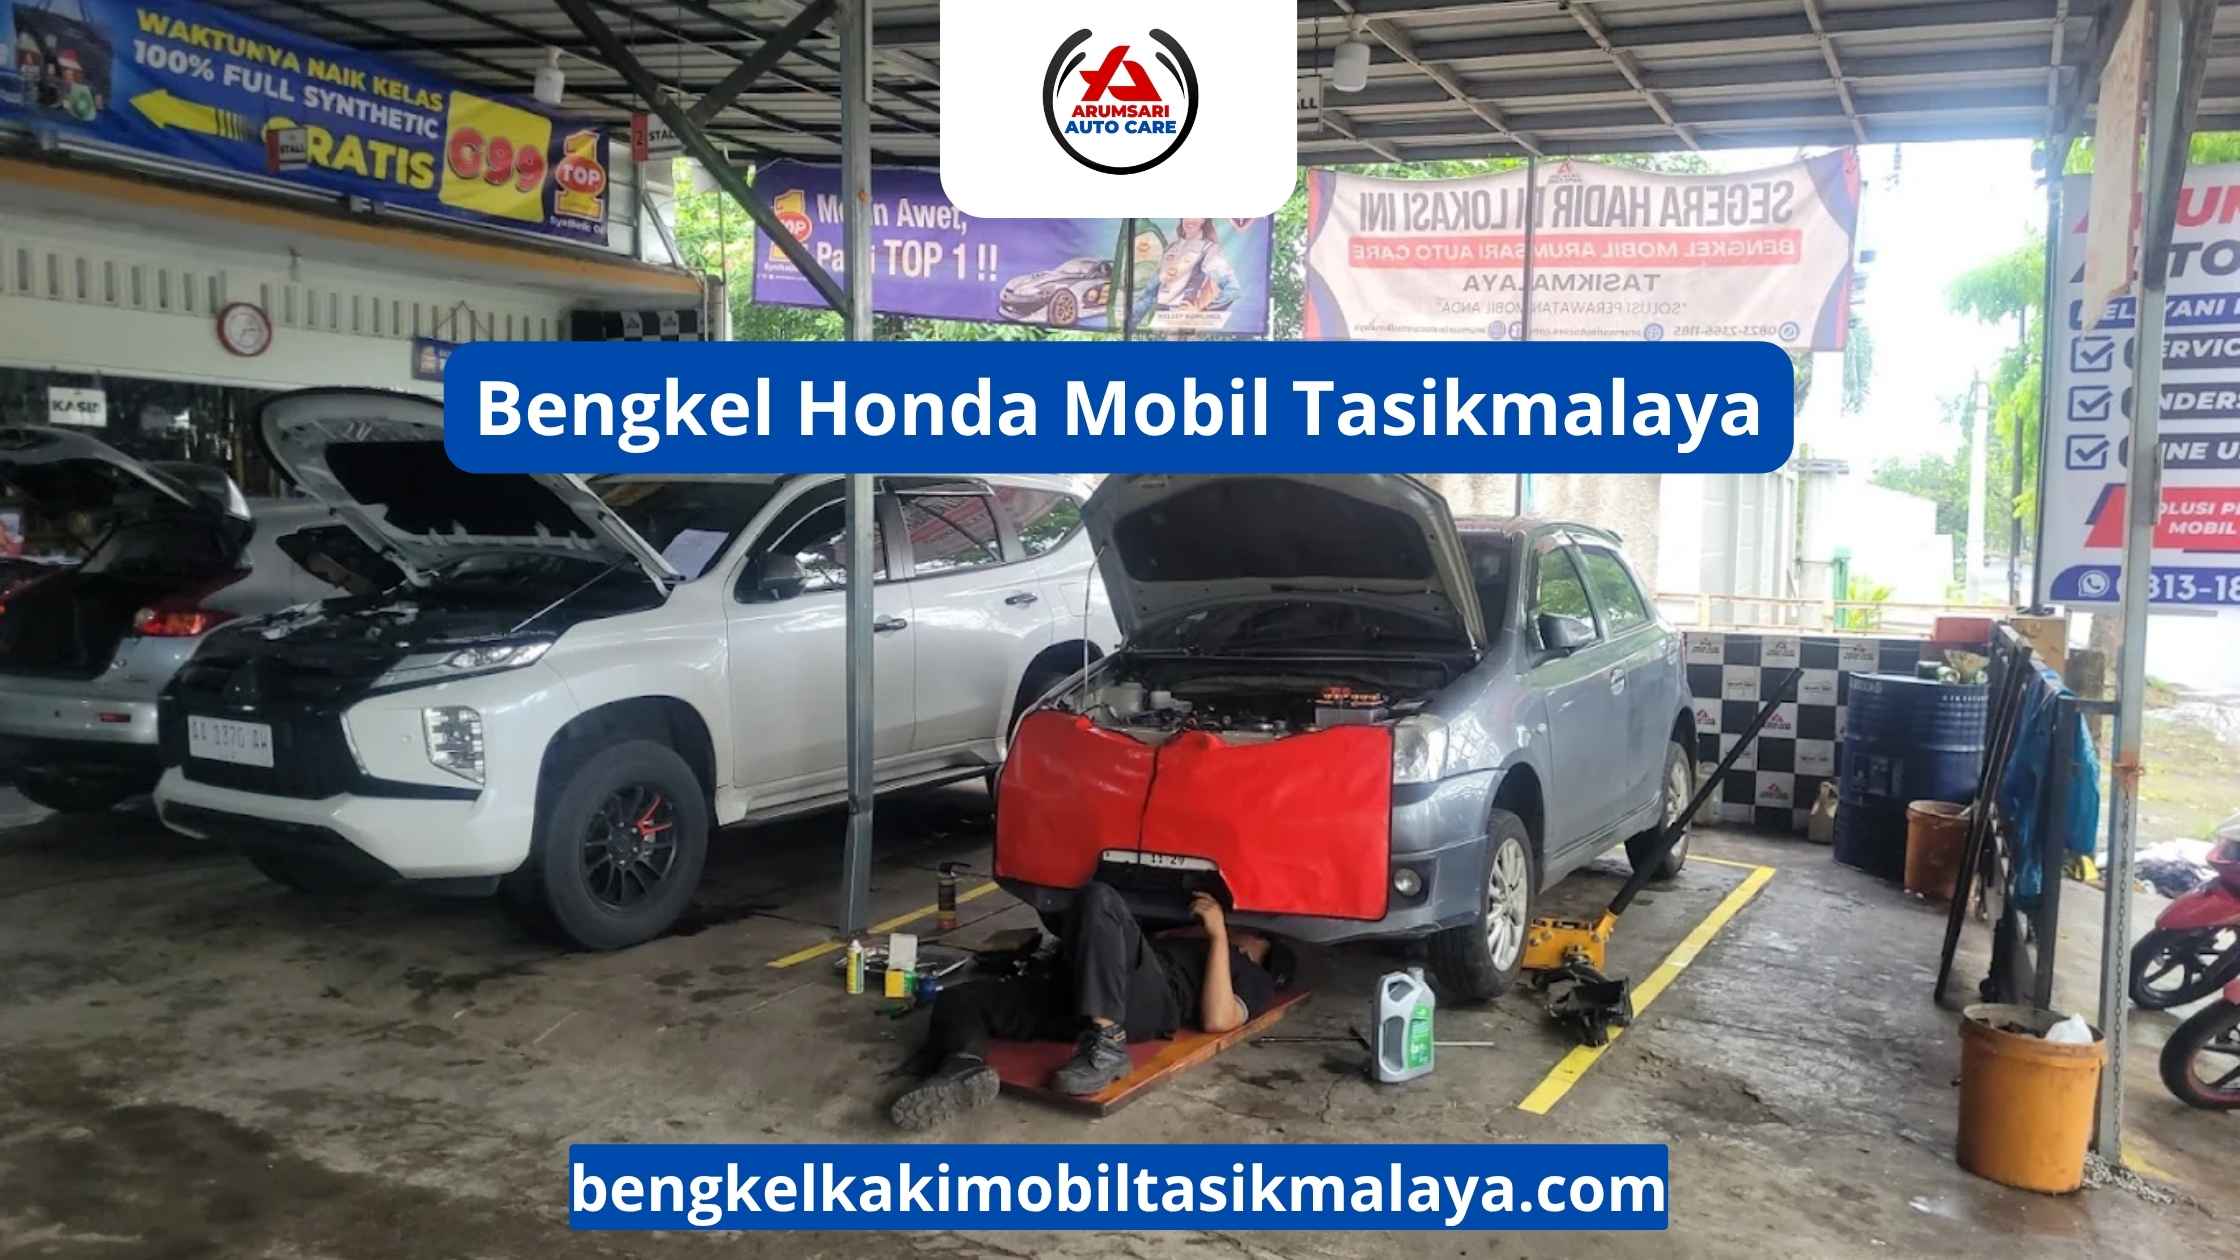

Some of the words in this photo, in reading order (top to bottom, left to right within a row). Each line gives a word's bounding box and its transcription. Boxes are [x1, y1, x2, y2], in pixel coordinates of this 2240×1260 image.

[137, 9, 300, 73] WAKTUNYA
[307, 57, 366, 91] NAIK
[373, 76, 443, 112] KELAS
[133, 39, 215, 82] 100%
[223, 64, 295, 102] FULL
[303, 85, 439, 139] SYNTHETIC
[562, 164, 599, 187] TOP
[896, 195, 968, 236] Awet,
[883, 238, 942, 278] TOP
[953, 244, 966, 280] 1
[2168, 521, 2238, 536] MOBIL
